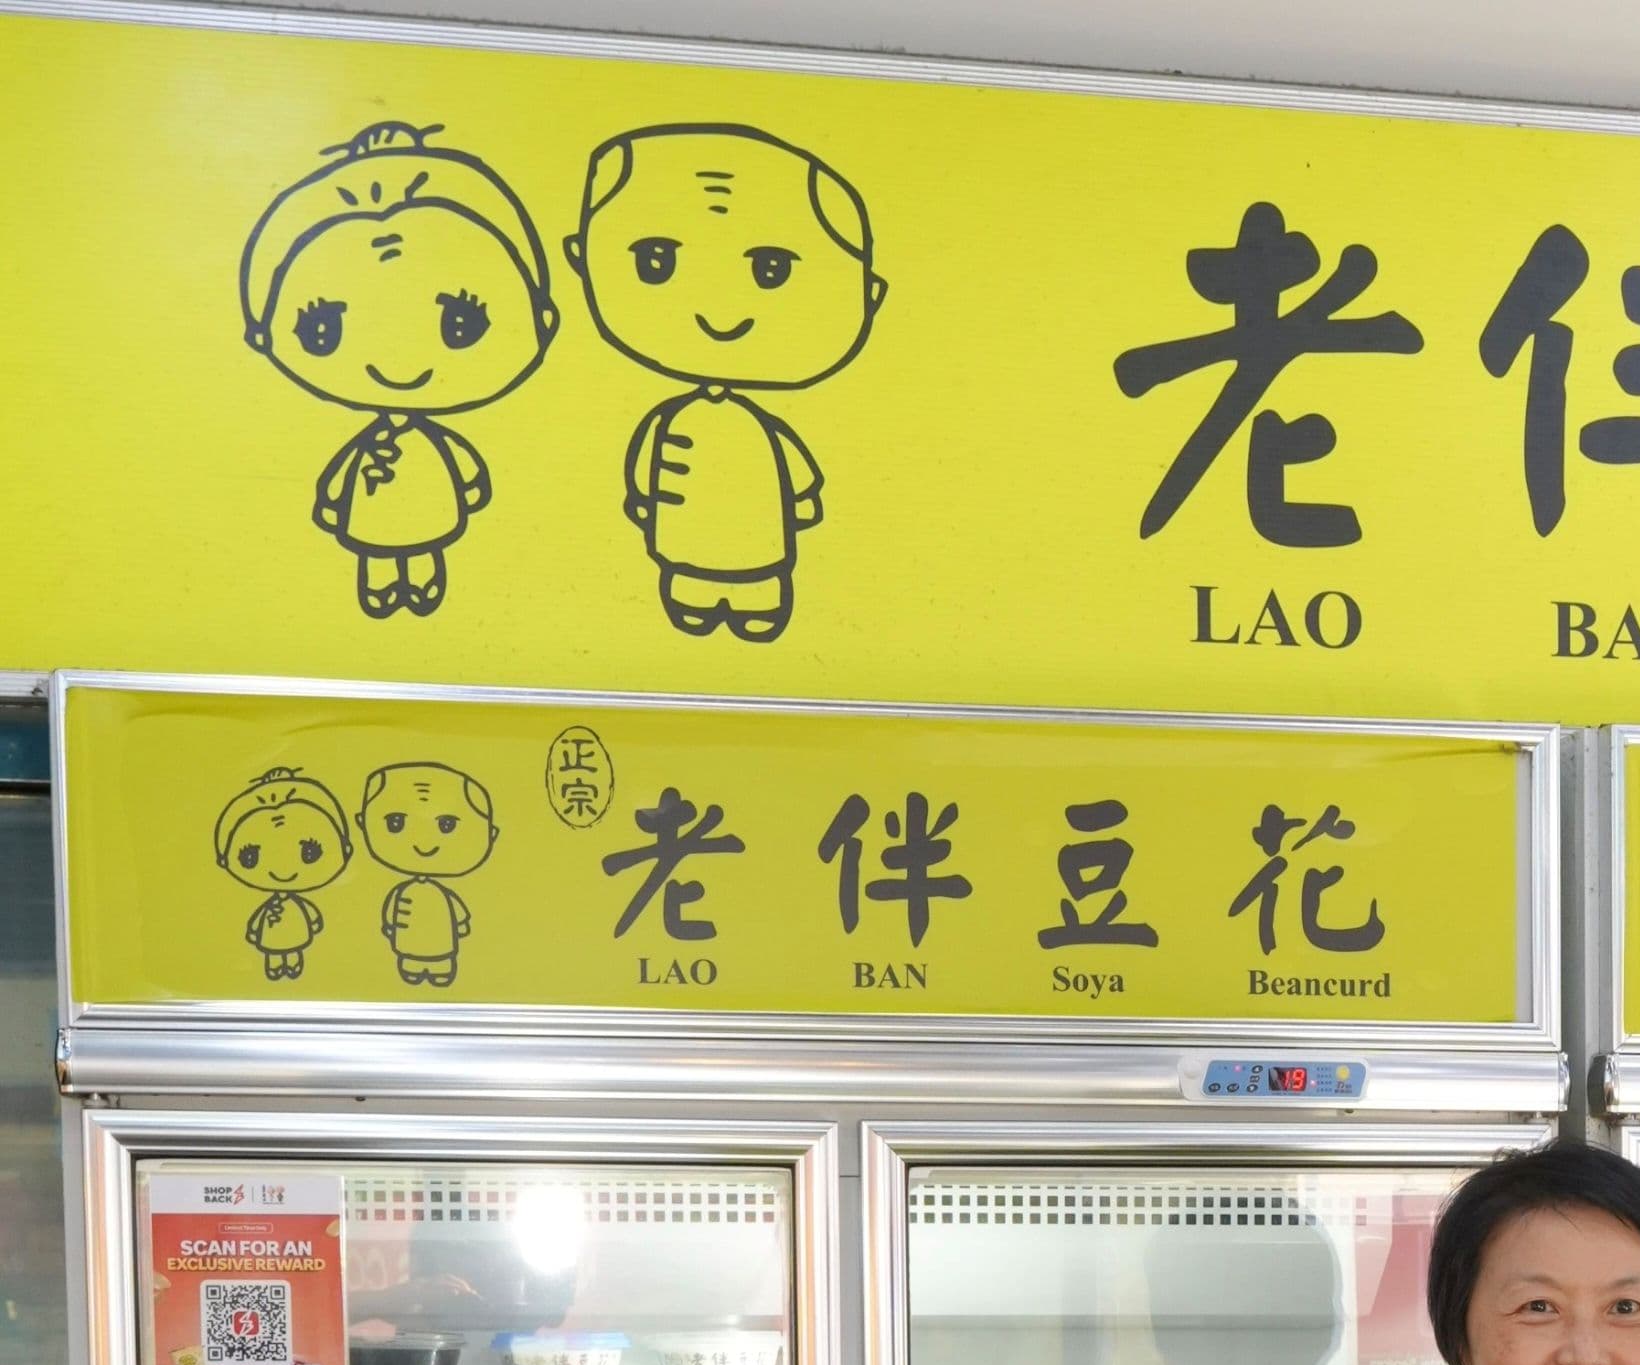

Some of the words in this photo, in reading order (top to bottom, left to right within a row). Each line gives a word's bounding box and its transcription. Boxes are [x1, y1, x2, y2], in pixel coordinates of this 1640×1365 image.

[1190, 584, 1365, 652] LAO
[559, 739, 598, 818] 正宗
[601, 786, 1385, 955] 老伴豆花
[638, 958, 718, 985] LAO
[852, 962, 929, 990] BAN
[1052, 966, 1125, 1000] Soya
[1247, 969, 1392, 999] Beancurd
[204, 1186, 233, 1194] SHOP
[204, 1195, 233, 1203] BACK
[180, 1240, 237, 1256] SCAN
[240, 1241, 279, 1256] FOR
[283, 1240, 312, 1256] AN
[167, 1258, 253, 1271] EXCLUSIVE
[255, 1258, 325, 1271] REWARD
